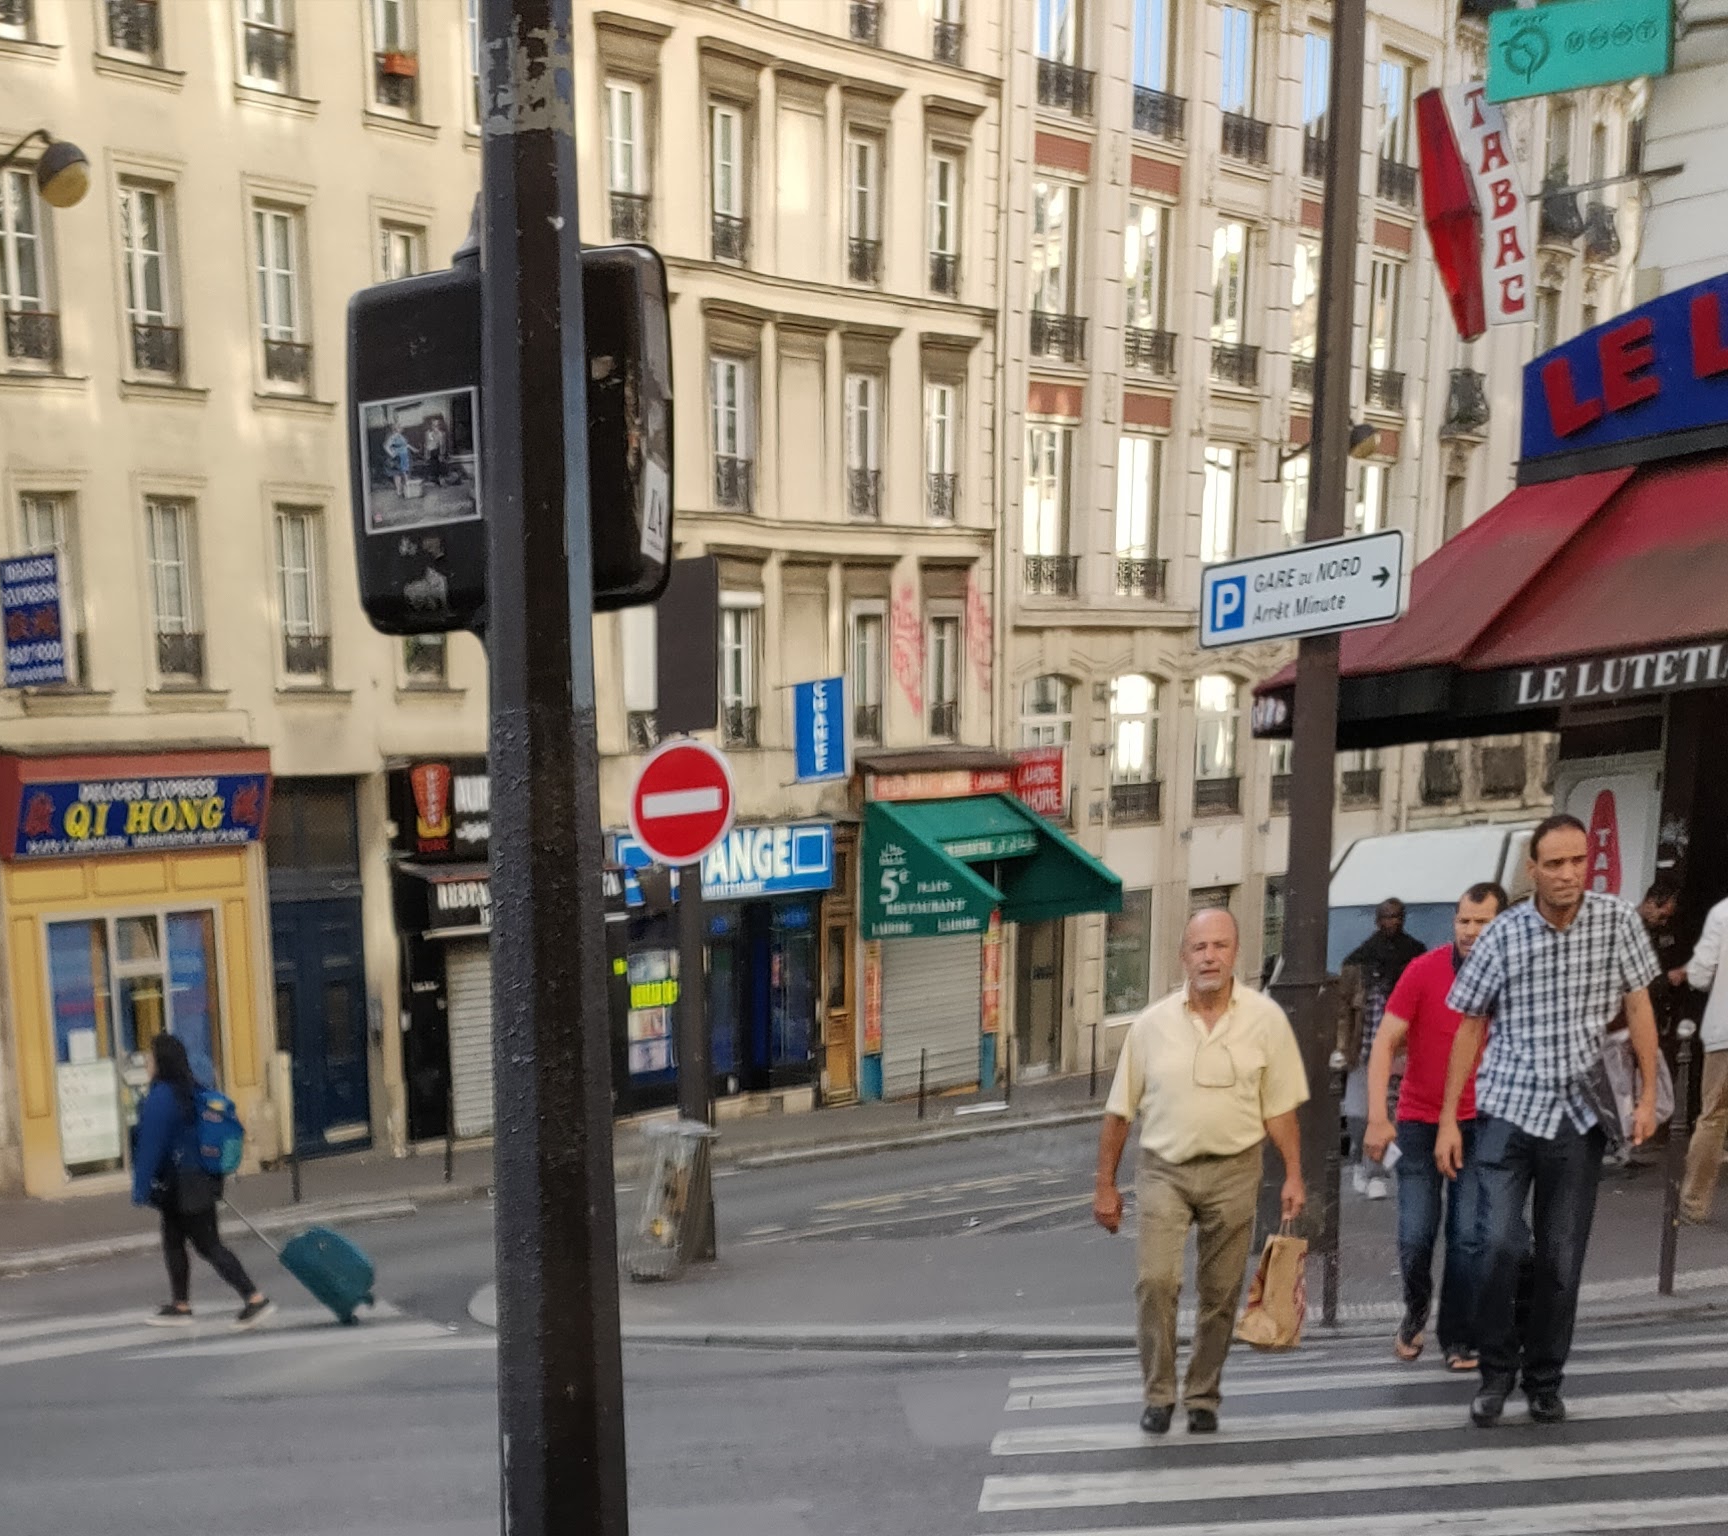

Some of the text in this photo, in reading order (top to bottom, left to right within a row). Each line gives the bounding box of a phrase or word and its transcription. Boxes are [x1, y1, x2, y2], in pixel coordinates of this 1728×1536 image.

[1464, 86, 1525, 314] TABAC
[1541, 316, 1662, 439] LE
[1254, 568, 1297, 593] GARE
[1316, 556, 1362, 582] NORD
[1295, 594, 1347, 615] Minute
[1517, 643, 1728, 705] LE LUTETI
[64, 802, 112, 839] QI
[126, 796, 224, 834] HONG
[705, 827, 792, 884] ANGE
